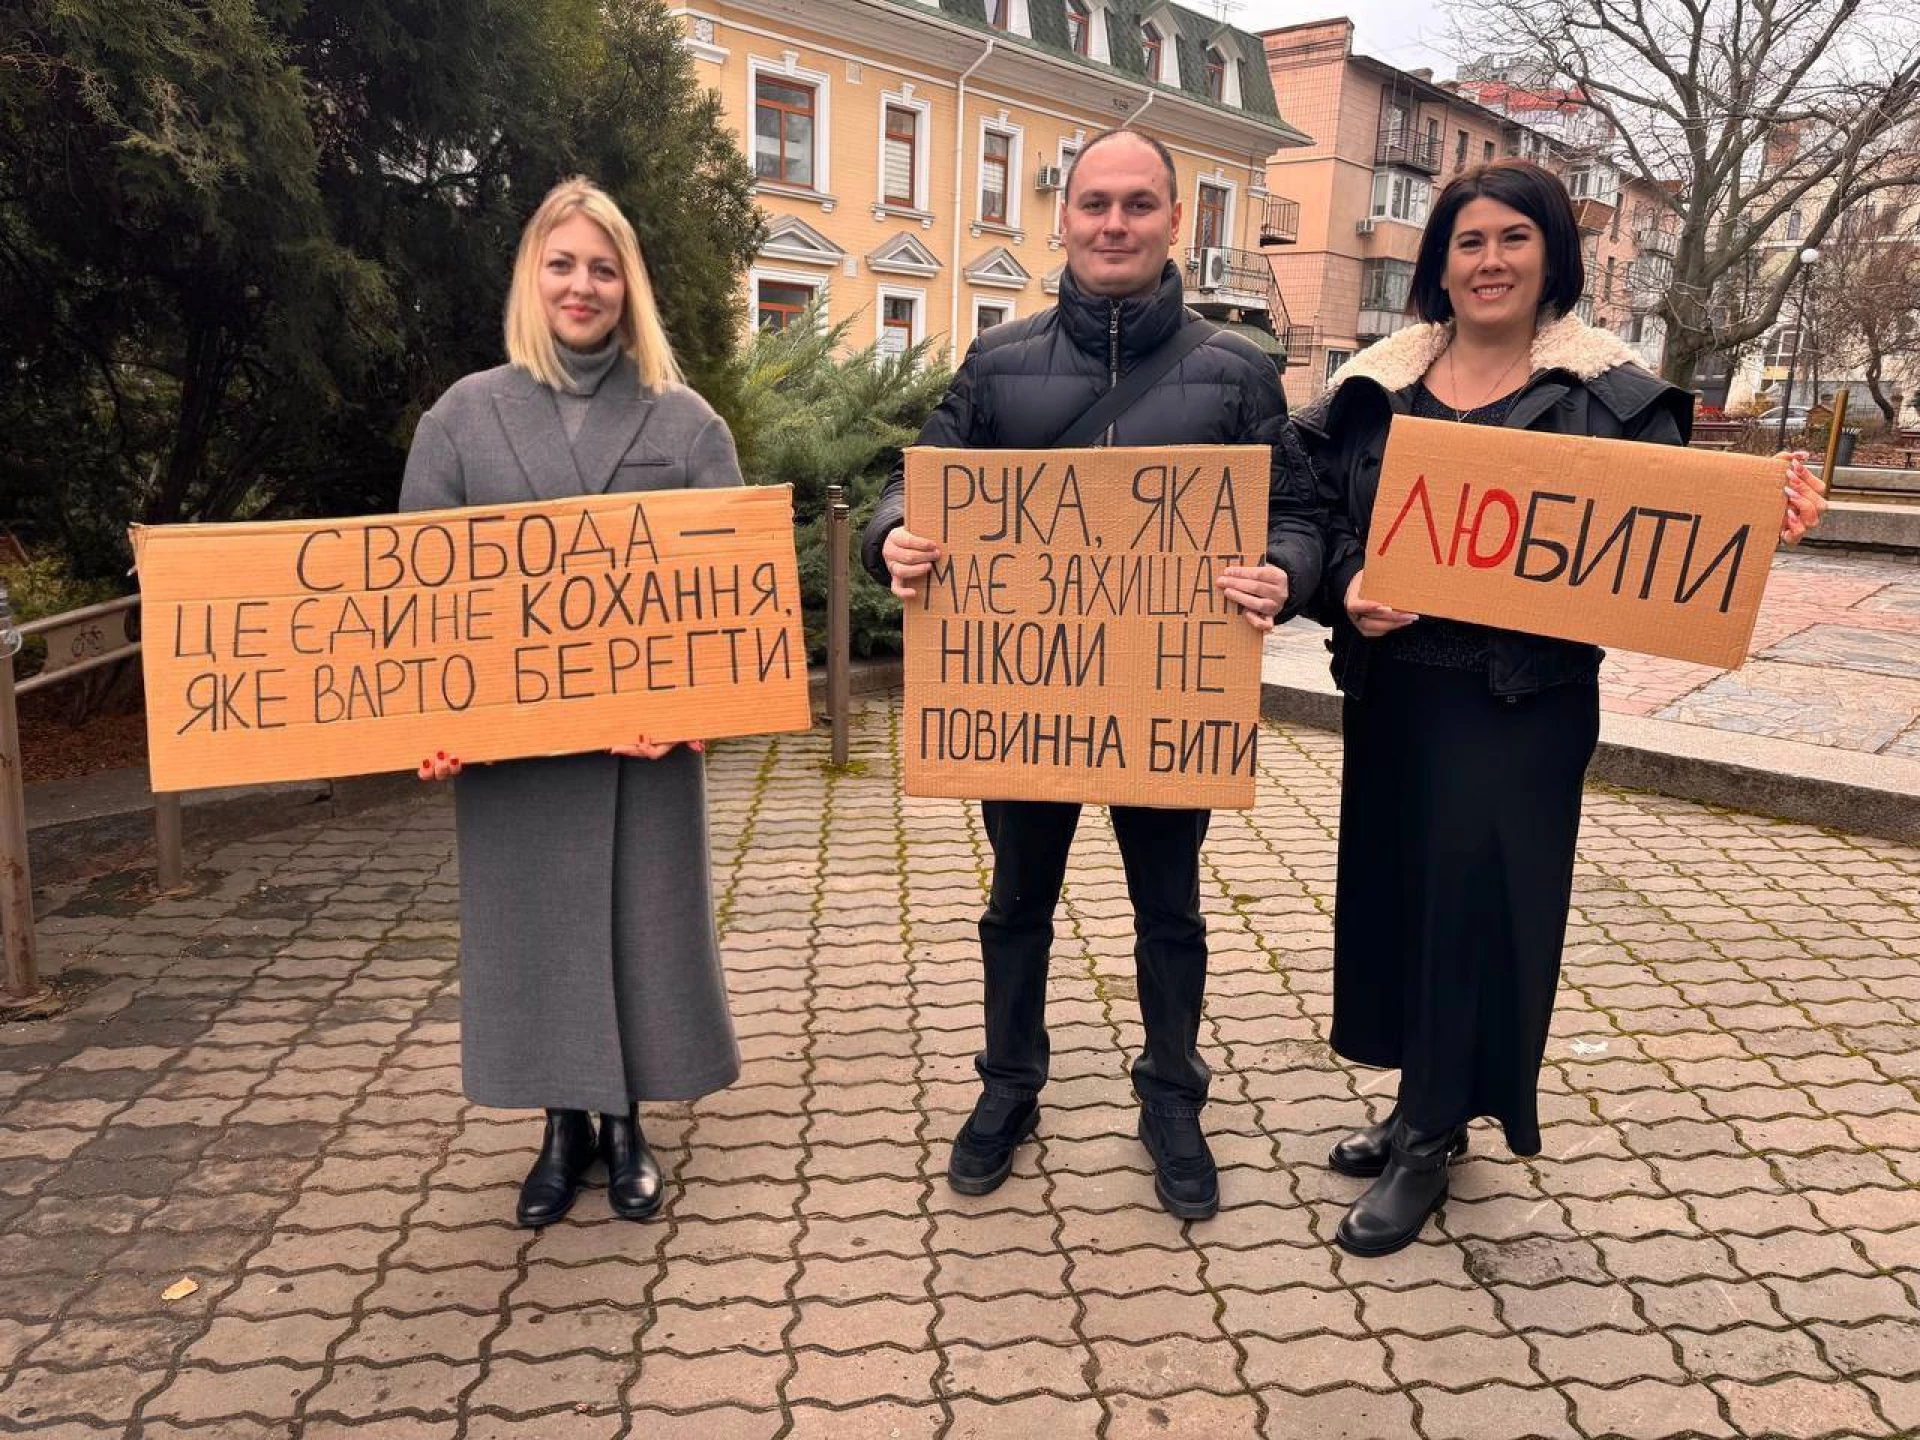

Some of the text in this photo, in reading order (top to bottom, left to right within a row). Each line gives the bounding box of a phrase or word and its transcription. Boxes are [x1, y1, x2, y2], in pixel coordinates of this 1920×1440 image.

[296, 503, 659, 592] СВОБОДА
[943, 462, 1242, 552] РУКА, ЯКА
[1377, 473, 1750, 613] ЛЮБИТИ
[924, 553, 1016, 615] МАЄ
[175, 601, 269, 663] ЦЕ
[290, 588, 494, 655] ЄДИНЕ
[941, 619, 1228, 694] НІКОЛИ НЕ
[177, 627, 791, 735] ЯКЕ ВАРТО БЕРЕГТИ
[920, 707, 1259, 778] ПОВИННА БИТИ
